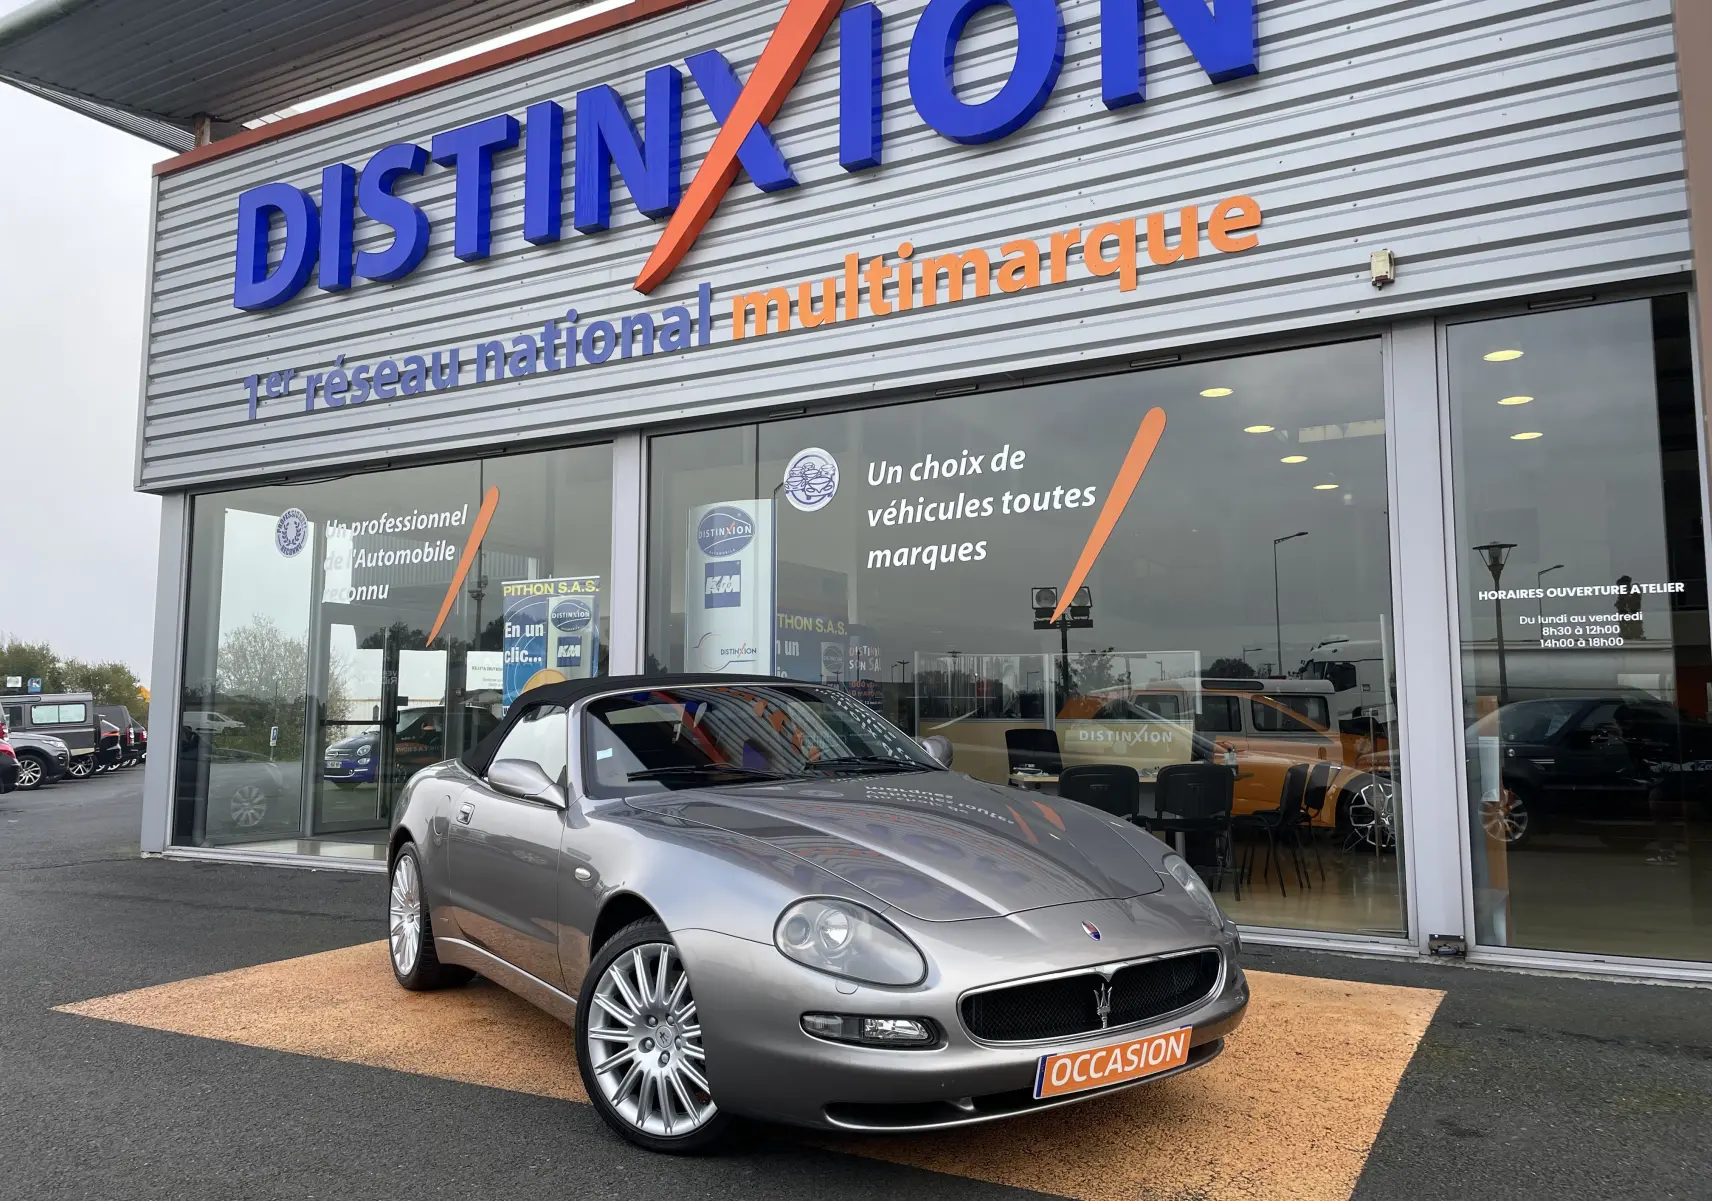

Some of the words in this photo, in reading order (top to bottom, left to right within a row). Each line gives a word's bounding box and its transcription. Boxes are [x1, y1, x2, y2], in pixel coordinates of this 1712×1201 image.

[233, 0, 1259, 312] DISTINXION
[243, 363, 297, 420] 1er
[304, 353, 460, 412] réseau
[475, 281, 713, 382] national
[732, 194, 1263, 340] multimarque
[867, 462, 904, 487] Un
[910, 450, 986, 483] choix
[990, 444, 1027, 473] de
[866, 493, 994, 527] véhicules
[1001, 483, 1097, 516] toutes
[326, 519, 348, 539] Un
[351, 503, 469, 537] professionnel
[698, 521, 752, 539] DISTINXION
[347, 539, 456, 570] l'Automobile
[866, 537, 988, 571] marques
[322, 584, 390, 603] reconnu
[503, 583, 554, 597] PITHON
[557, 580, 600, 594] S.A.S.
[1478, 588, 1544, 601] HORAIRES
[1546, 584, 1628, 598] OUVERTURE
[1630, 582, 1685, 594] ATELIER
[815, 618, 848, 635] S.A.S.
[1519, 615, 1535, 625] Du
[1538, 613, 1567, 625] lundi
[1570, 615, 1586, 624] au
[1589, 611, 1643, 623] vendredi
[504, 622, 520, 638] En
[525, 623, 544, 637] un
[1542, 626, 1572, 636] 8h30
[1575, 624, 1583, 635] à
[1585, 624, 1620, 635] 12h00
[720, 642, 757, 659] DISTINXION
[784, 640, 800, 656] un
[1540, 637, 1574, 648] 14h00
[1577, 636, 1586, 647] à
[1589, 636, 1624, 647] 18h00
[504, 646, 542, 663] clic...
[1078, 724, 1173, 746] DISTINXION
[1051, 1033, 1186, 1087] OCCASION
